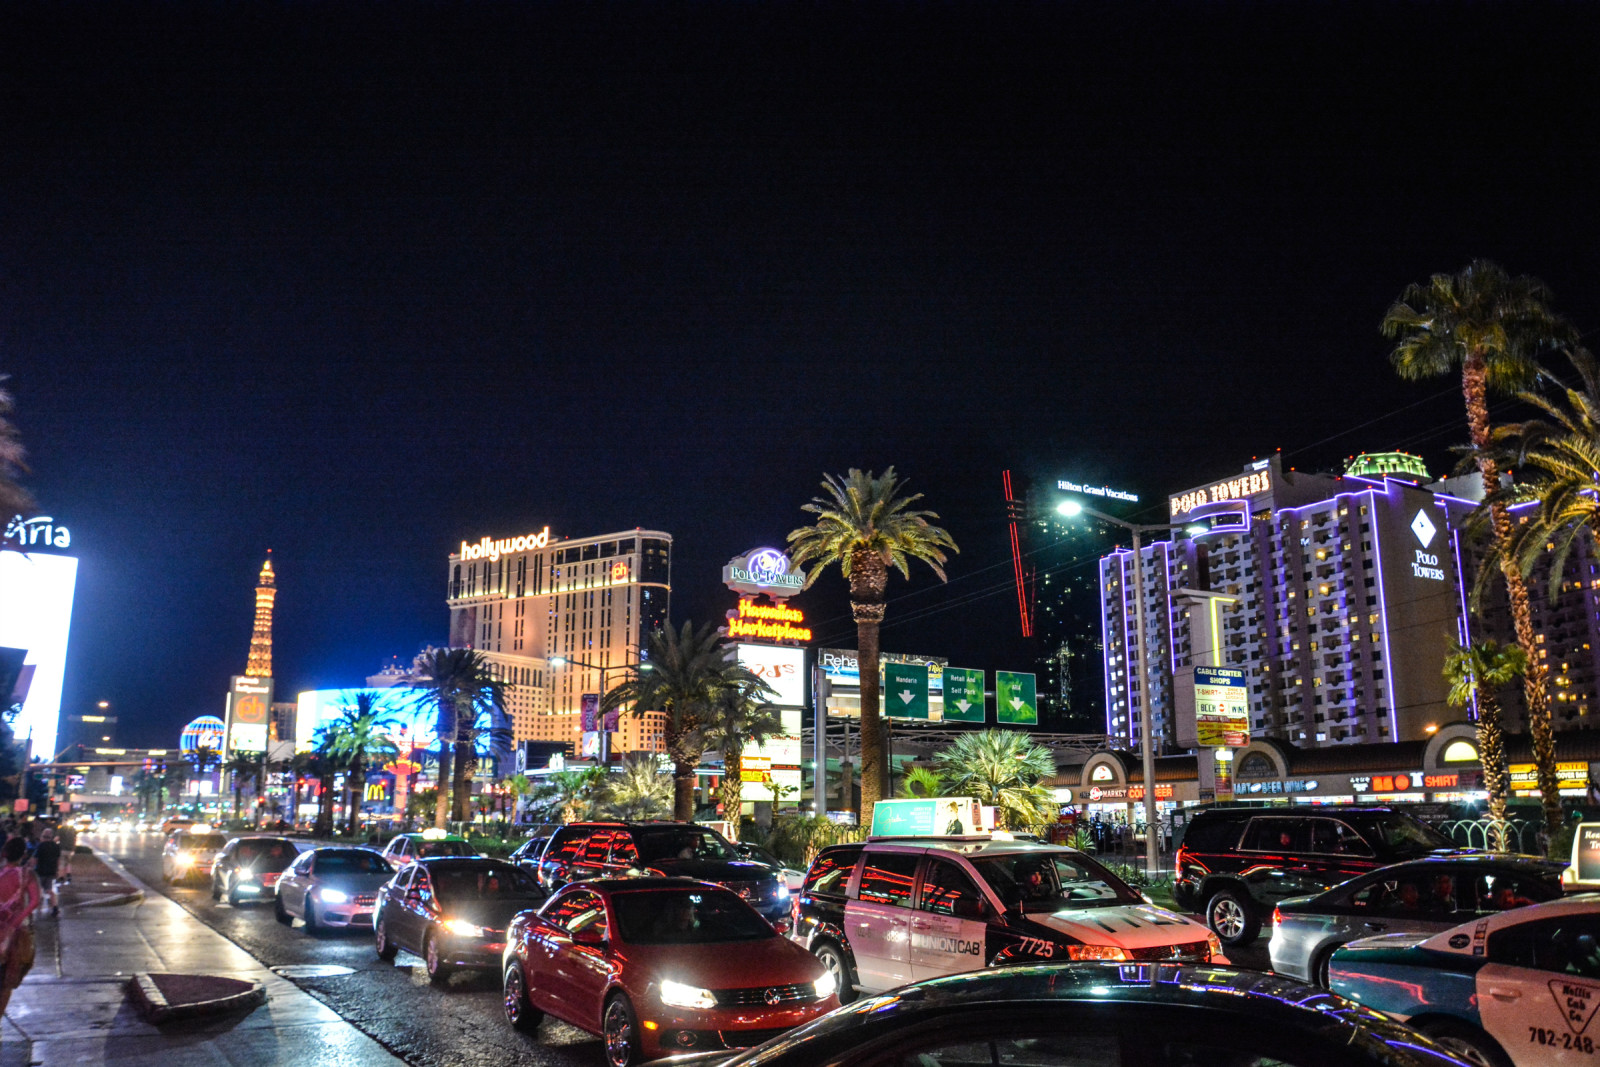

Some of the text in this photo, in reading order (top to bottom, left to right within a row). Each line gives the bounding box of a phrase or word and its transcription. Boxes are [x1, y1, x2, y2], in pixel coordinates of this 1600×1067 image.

[1057, 480, 1138, 502] Hilton Grand Vacations
[1171, 470, 1270, 516] POLO TOWERS
[460, 526, 550, 562] hollywood
[728, 618, 812, 641] Marketplace
[1218, 669, 1242, 677] CENTER
[895, 676, 917, 684] Mandarin
[1210, 677, 1231, 685] SHOPS
[1261, 781, 1282, 794] BEER
[1424, 774, 1459, 788] SHIRT
[1101, 789, 1127, 798] MARKET
[1128, 788, 1146, 798] COL
[920, 933, 957, 954] UNION
[957, 939, 980, 956] CAB
[1019, 936, 1054, 958] 7725
[1567, 997, 1586, 1010] Cab
[1569, 1009, 1584, 1022] Co.
